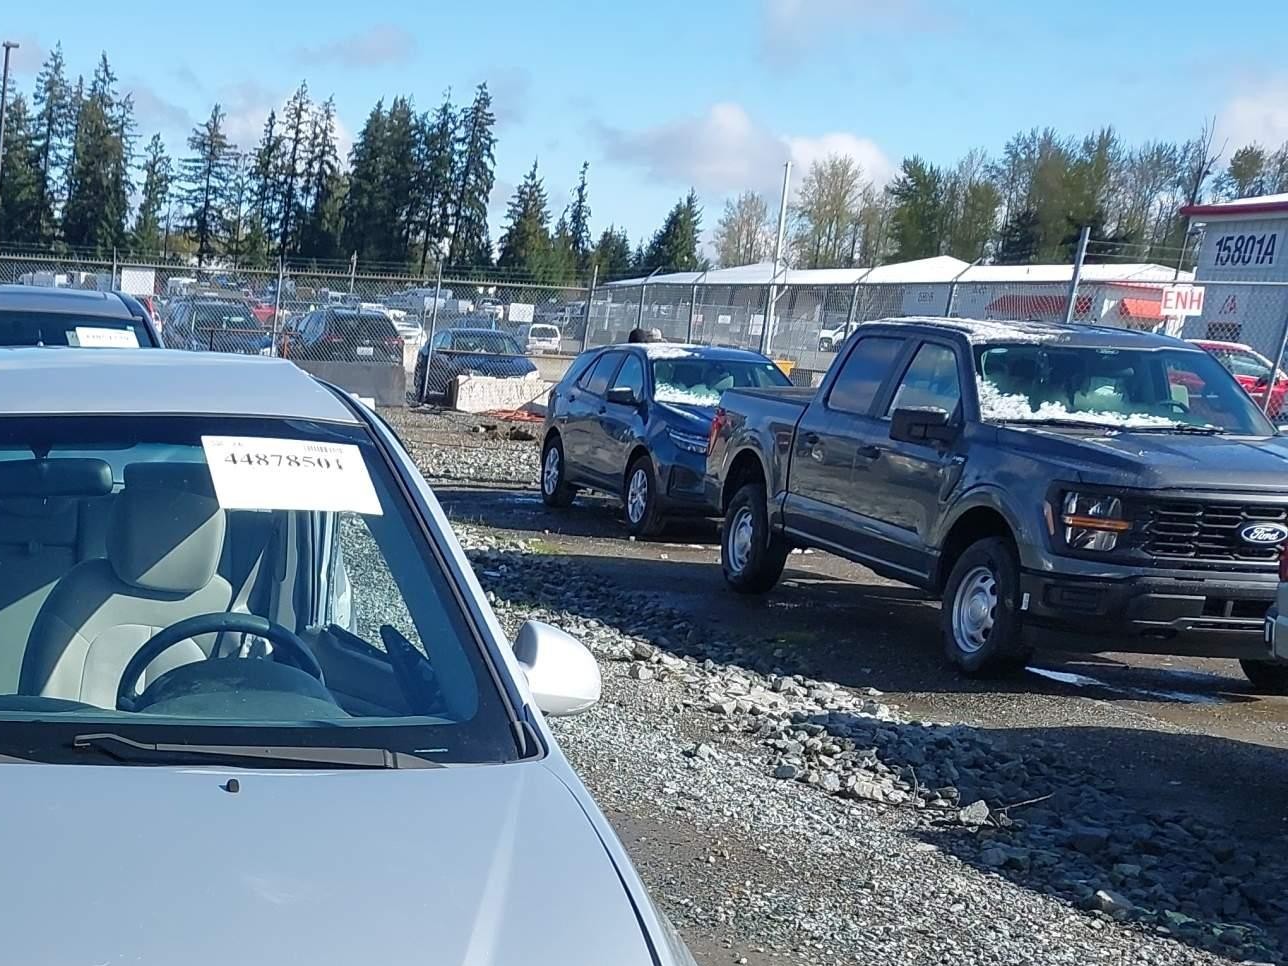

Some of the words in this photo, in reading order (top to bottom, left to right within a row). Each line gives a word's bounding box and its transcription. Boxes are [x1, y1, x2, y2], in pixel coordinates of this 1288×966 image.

[1214, 233, 1278, 266] 15801A
[1163, 291, 1203, 310] ENH
[224, 453, 343, 470] 44878501
[1250, 528, 1279, 540] Ford
